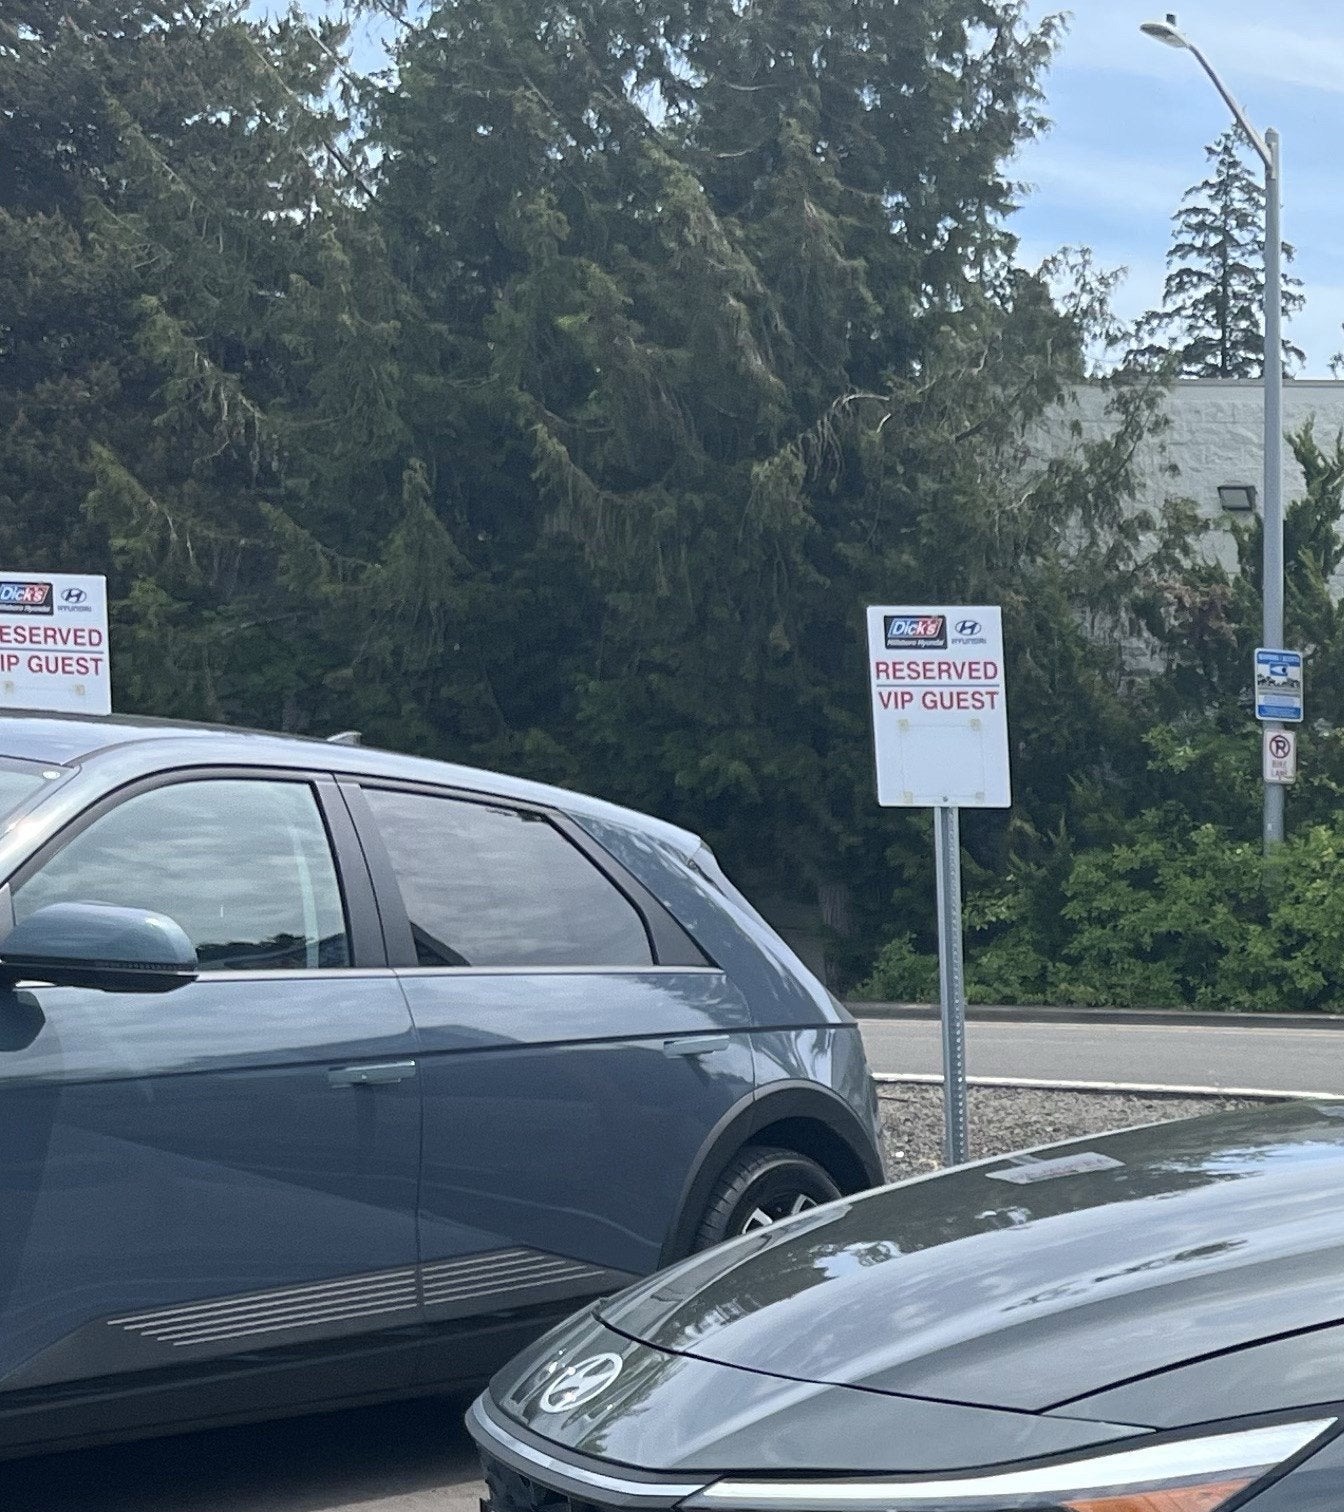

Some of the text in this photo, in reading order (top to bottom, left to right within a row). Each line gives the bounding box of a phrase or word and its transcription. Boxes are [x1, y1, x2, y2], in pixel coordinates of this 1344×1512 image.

[0, 625, 103, 647] ESERVED
[28, 655, 103, 675] GUEST
[875, 661, 998, 680] RESERVED
[878, 691, 999, 710] VIP GUEST
